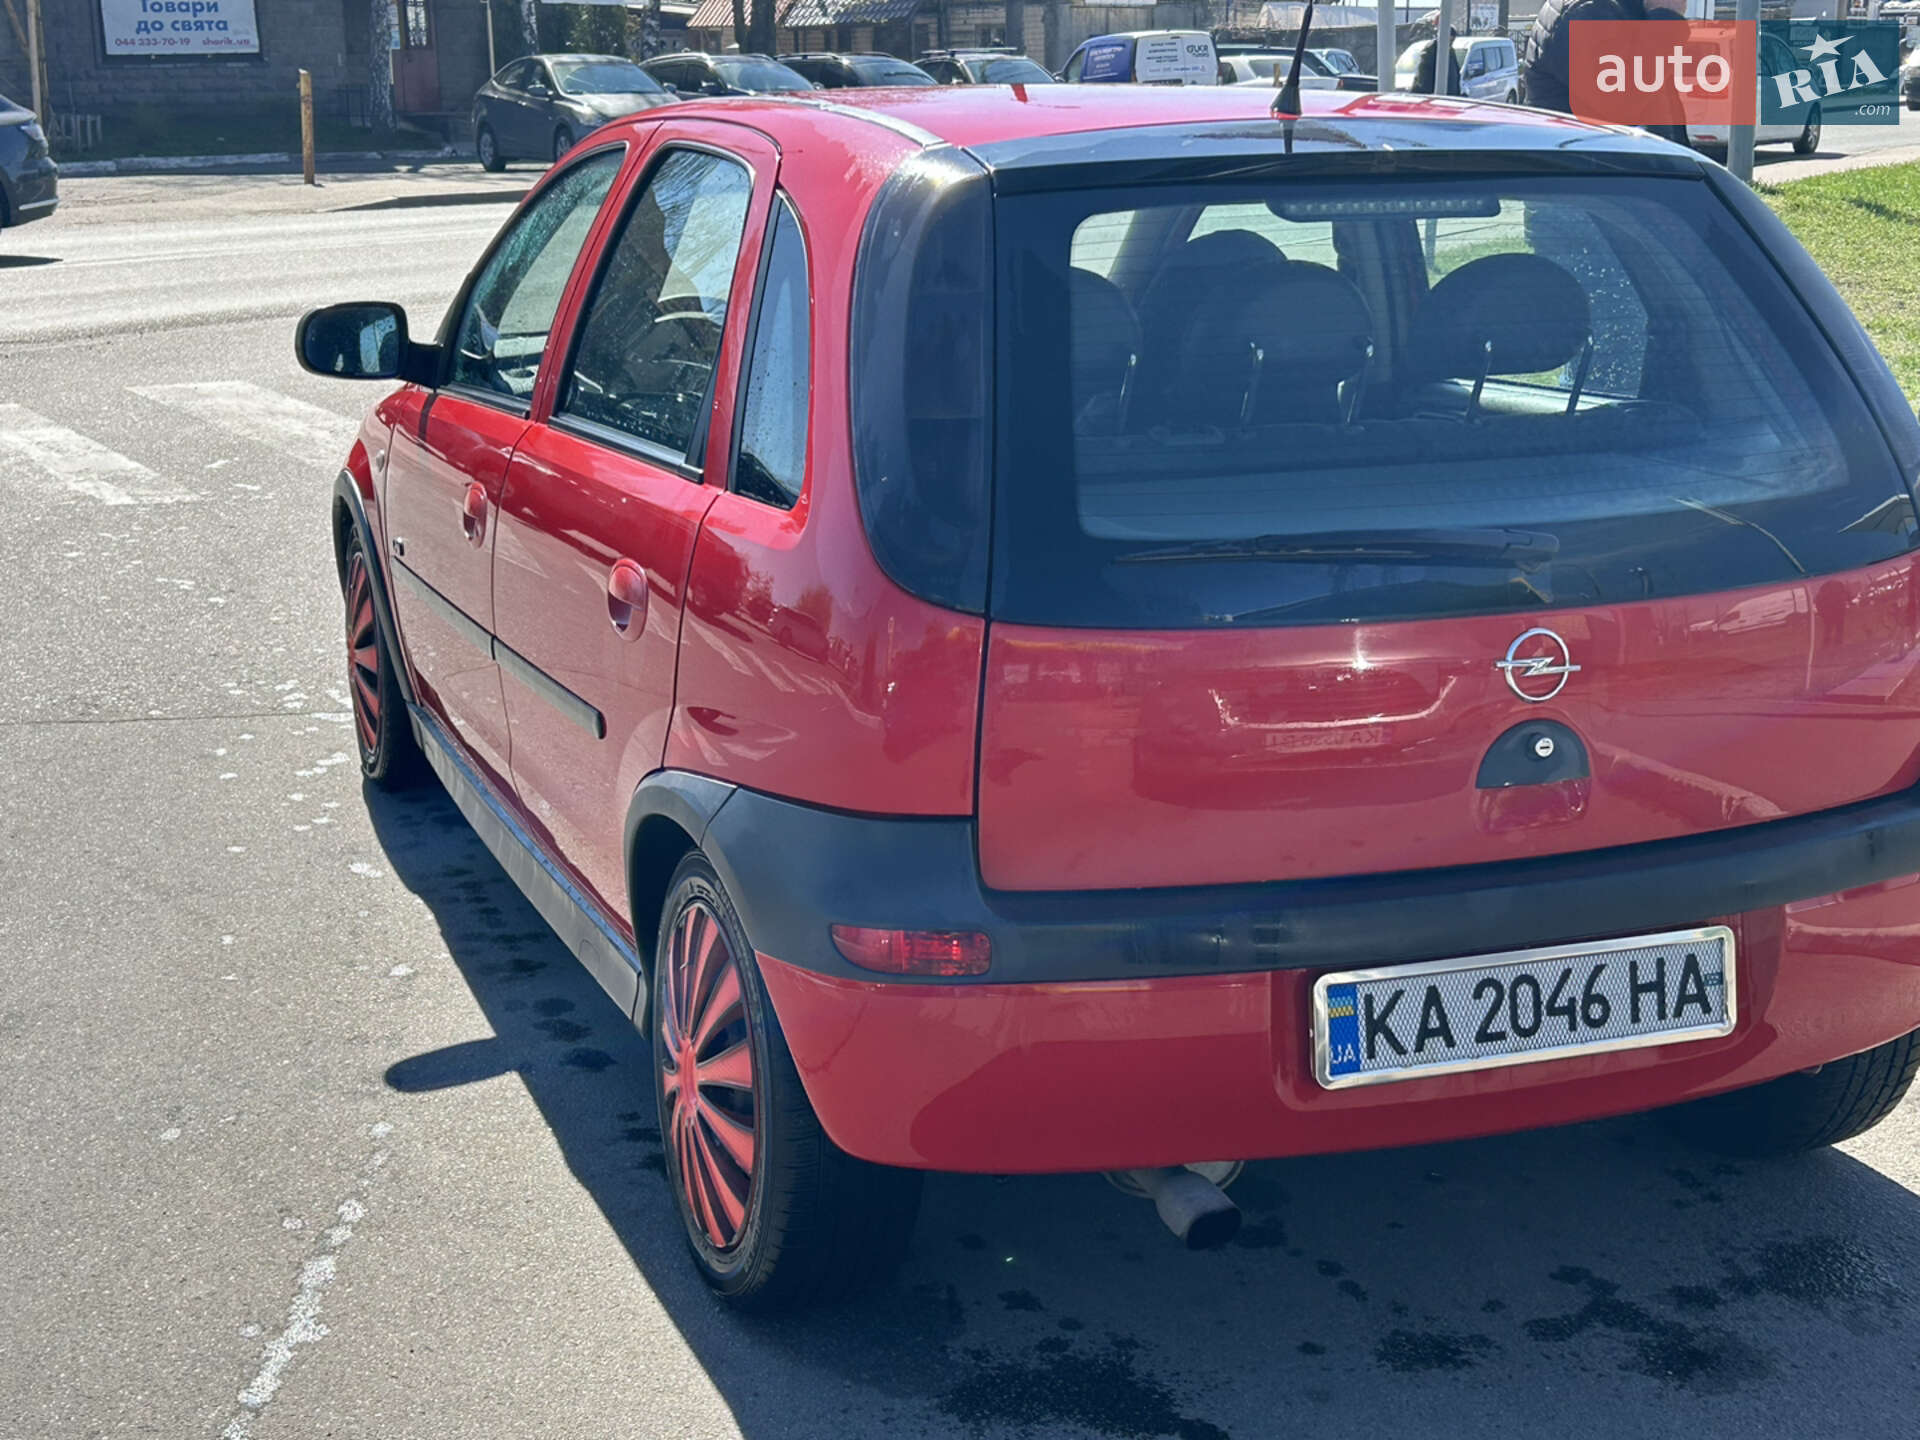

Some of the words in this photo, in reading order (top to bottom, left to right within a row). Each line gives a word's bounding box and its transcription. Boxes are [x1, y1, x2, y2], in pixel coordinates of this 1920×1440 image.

[140, 0, 219, 18] Товари
[136, 19, 164, 34] до
[170, 19, 229, 32] свята
[114, 37, 137, 47] 044
[1364, 984, 1457, 1060] KA
[1473, 963, 1611, 1044] 2046
[1628, 952, 1713, 1025] HA
